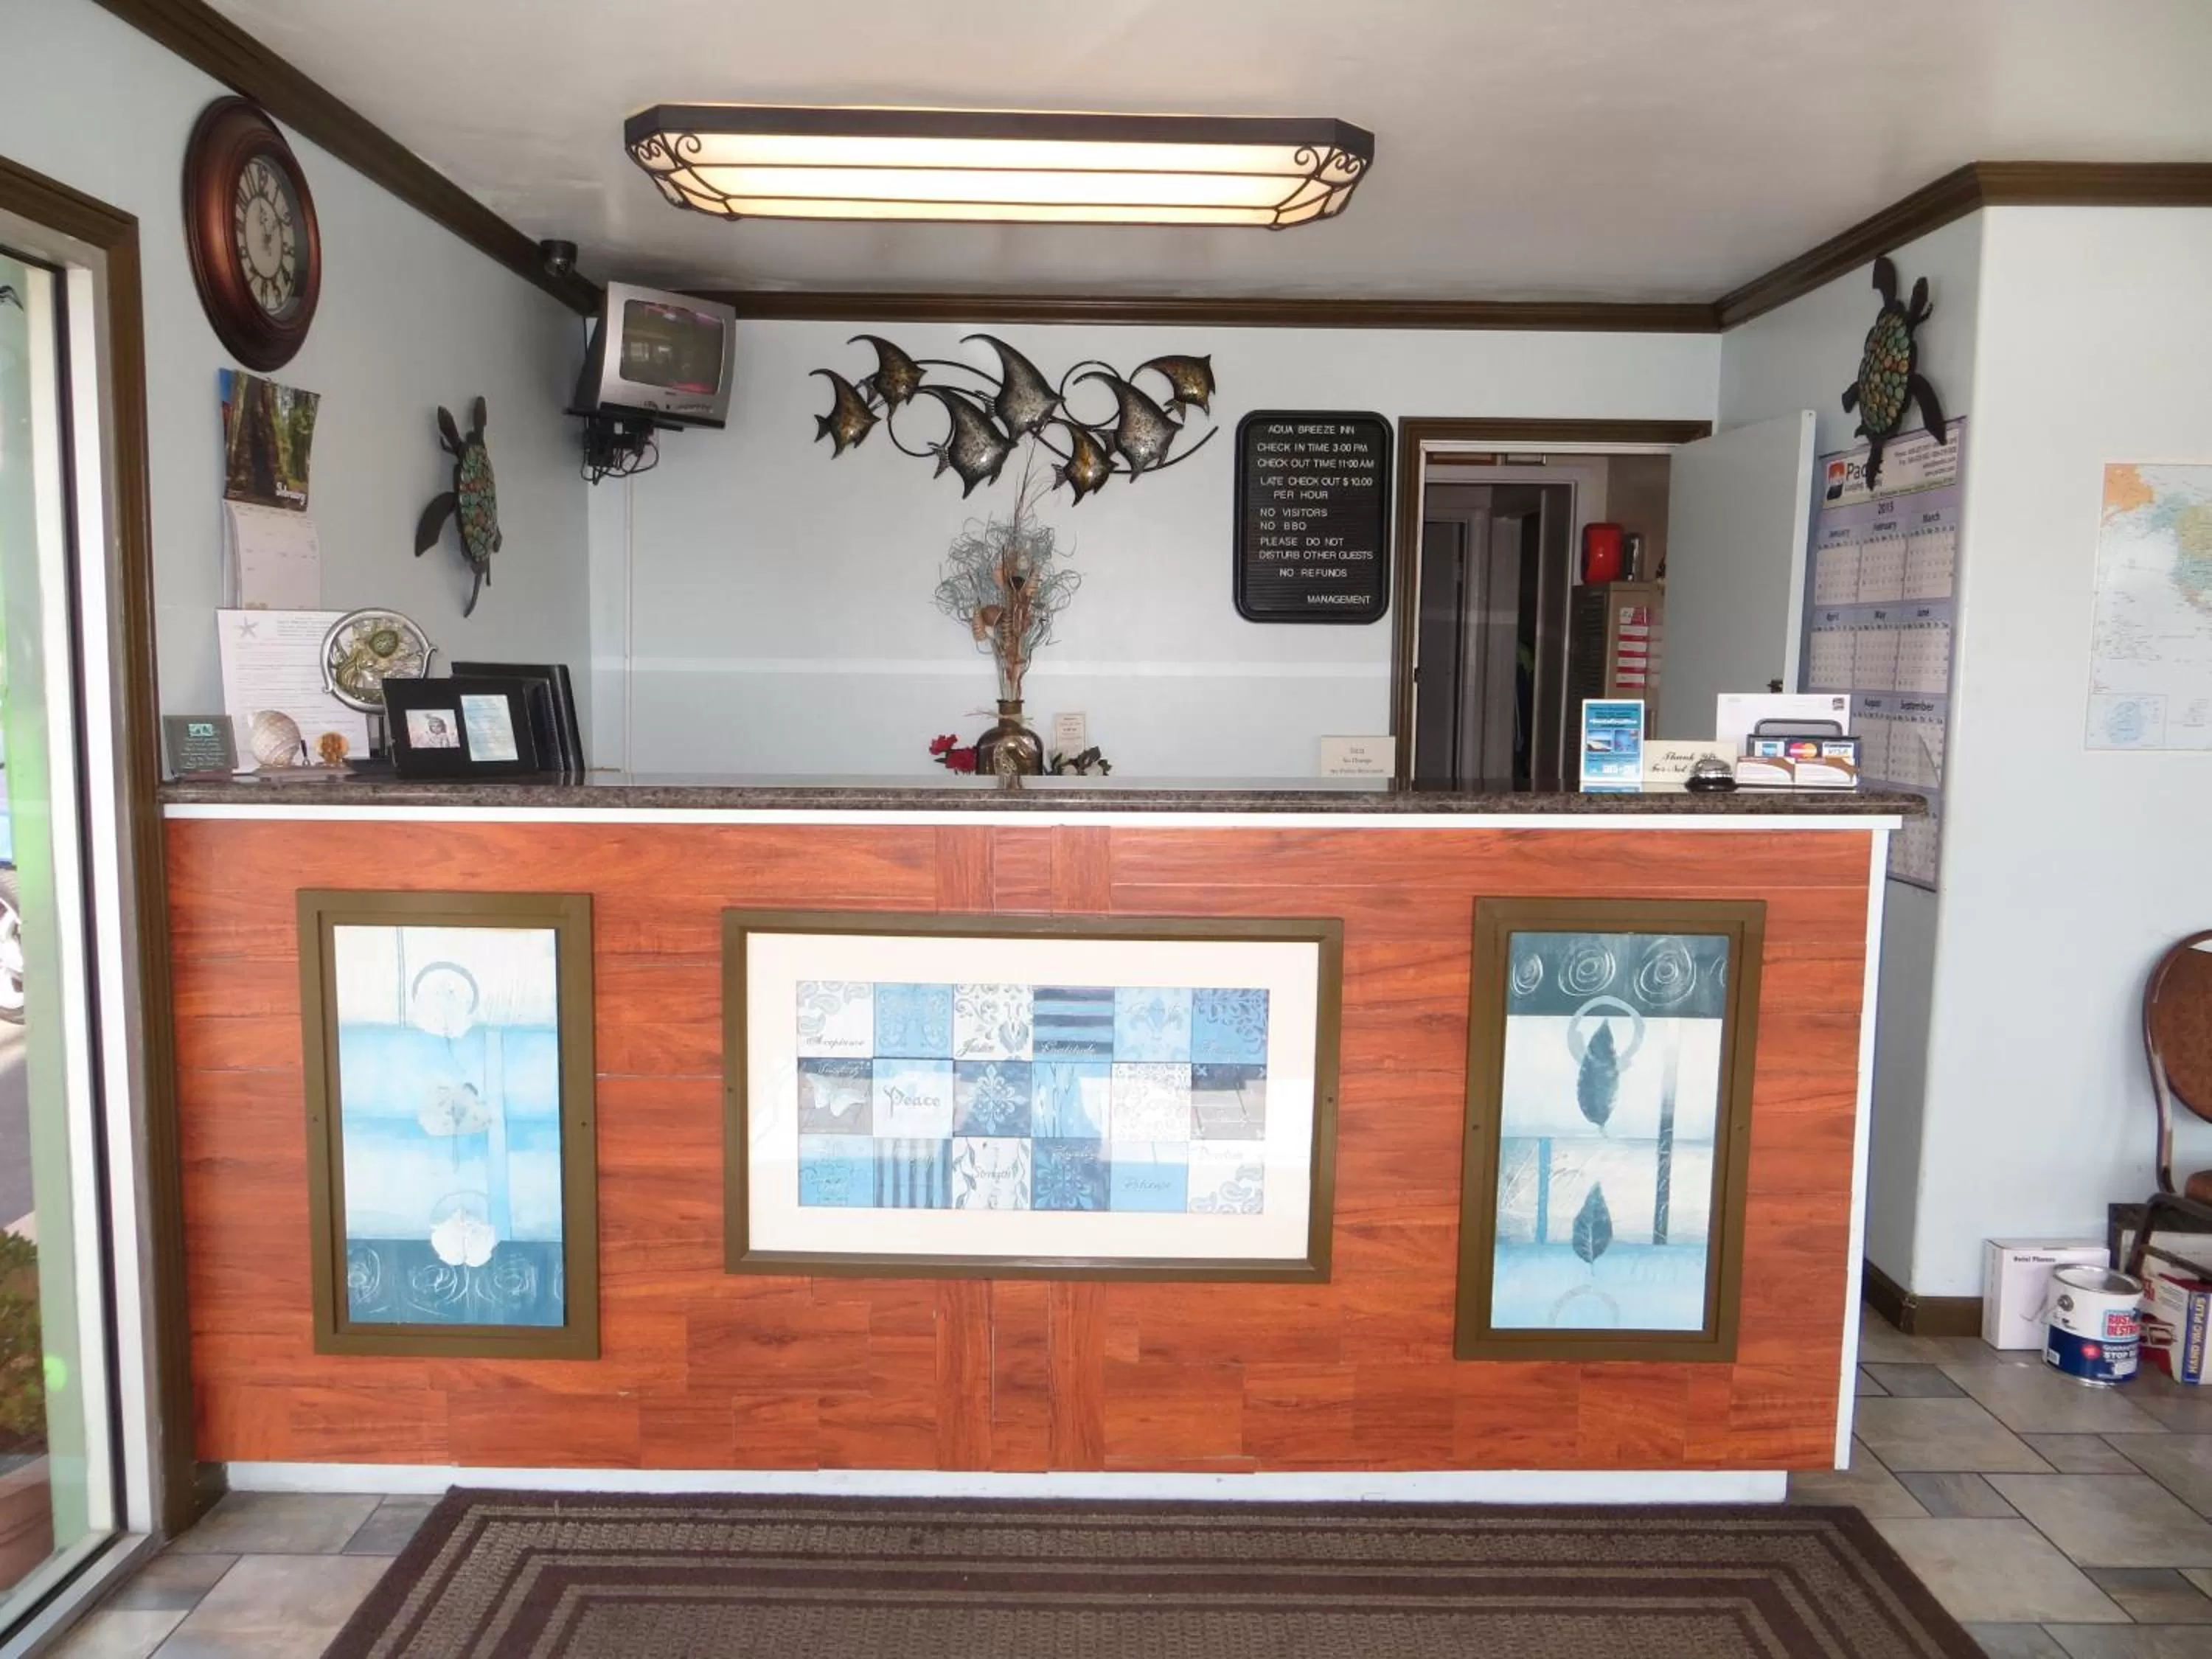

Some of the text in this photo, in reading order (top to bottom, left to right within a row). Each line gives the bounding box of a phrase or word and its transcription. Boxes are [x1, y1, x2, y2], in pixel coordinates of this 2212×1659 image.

[1267, 425, 1355, 434] AQUA BREEZE INN
[1257, 443, 1290, 452] CHECK
[1295, 443, 1305, 452] IN
[1307, 443, 1329, 452] TIME
[1353, 443, 1368, 452] PM
[1257, 459, 1374, 468] CHECK OUT TIME 11:00 AM
[1260, 476, 1284, 487] LATE
[1288, 476, 1319, 487] CHECK
[1321, 476, 1340, 487] OUT
[1273, 490, 1329, 499] PER HOUR
[1260, 508, 1328, 517] NO VISITORS
[1260, 521, 1307, 531] NO BBQ
[1260, 537, 1344, 546] PLEASE DO NOT
[1259, 551, 1374, 560] DISTURB OTHER GUESTS
[1279, 568, 1347, 577] NO REFUNDS
[1307, 595, 1371, 605] MANAGEMENT
[883, 1085, 941, 1119] Peace
